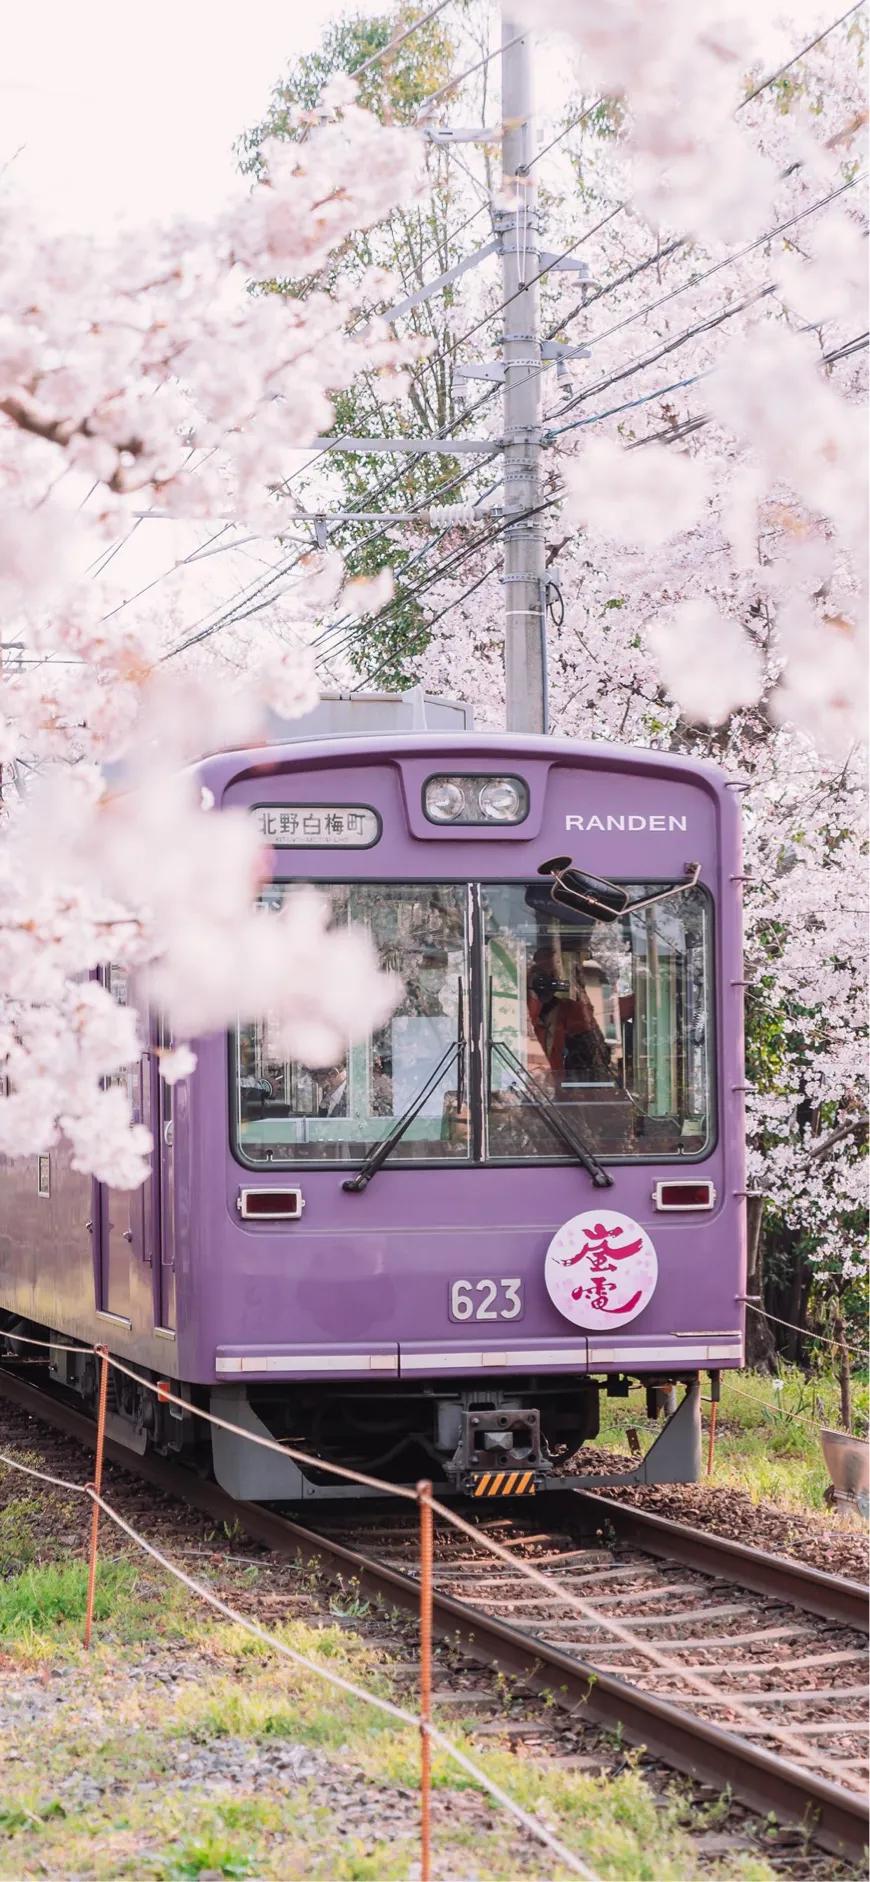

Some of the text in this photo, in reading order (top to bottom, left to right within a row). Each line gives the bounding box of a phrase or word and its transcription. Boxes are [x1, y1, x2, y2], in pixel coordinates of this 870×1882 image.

[259, 813, 366, 836] 北野白梅町
[565, 815, 687, 832] RANDEN
[451, 1278, 522, 1320] 623
